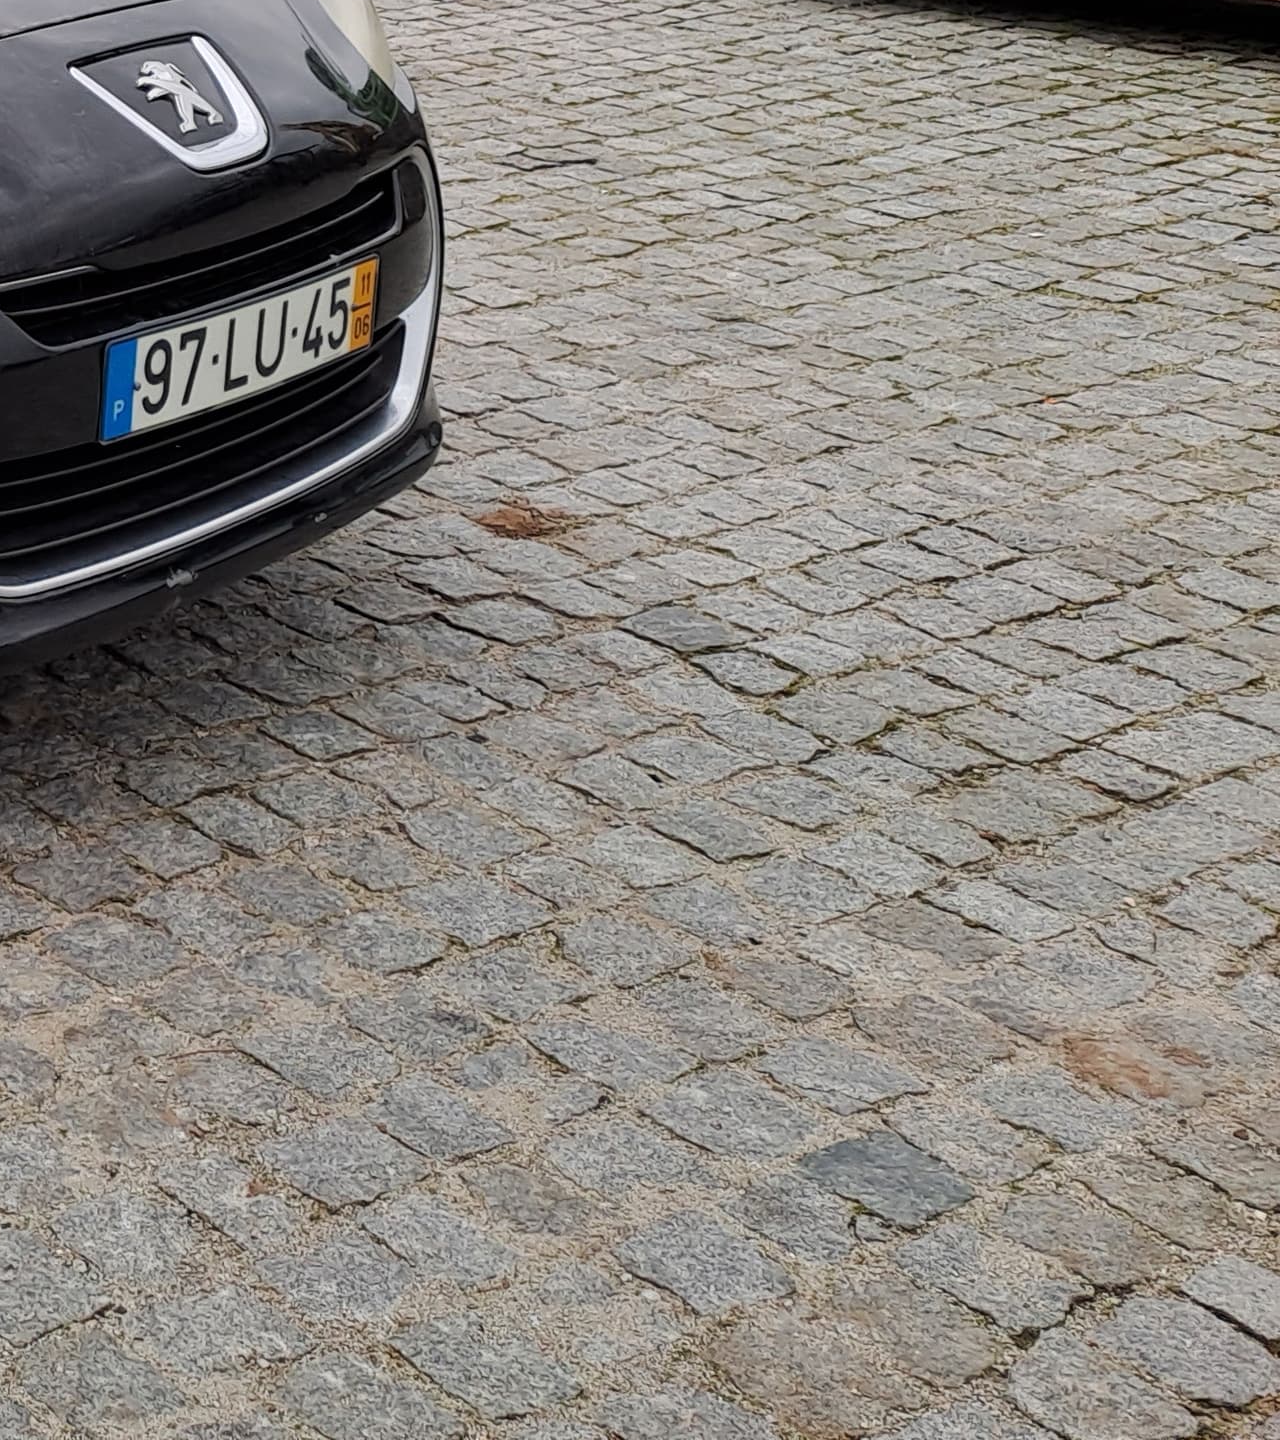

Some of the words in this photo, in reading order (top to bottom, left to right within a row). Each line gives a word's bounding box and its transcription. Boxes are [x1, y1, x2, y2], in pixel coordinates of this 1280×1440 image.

[361, 271, 372, 296] 11
[354, 313, 371, 340] 06
[113, 400, 124, 421] P
